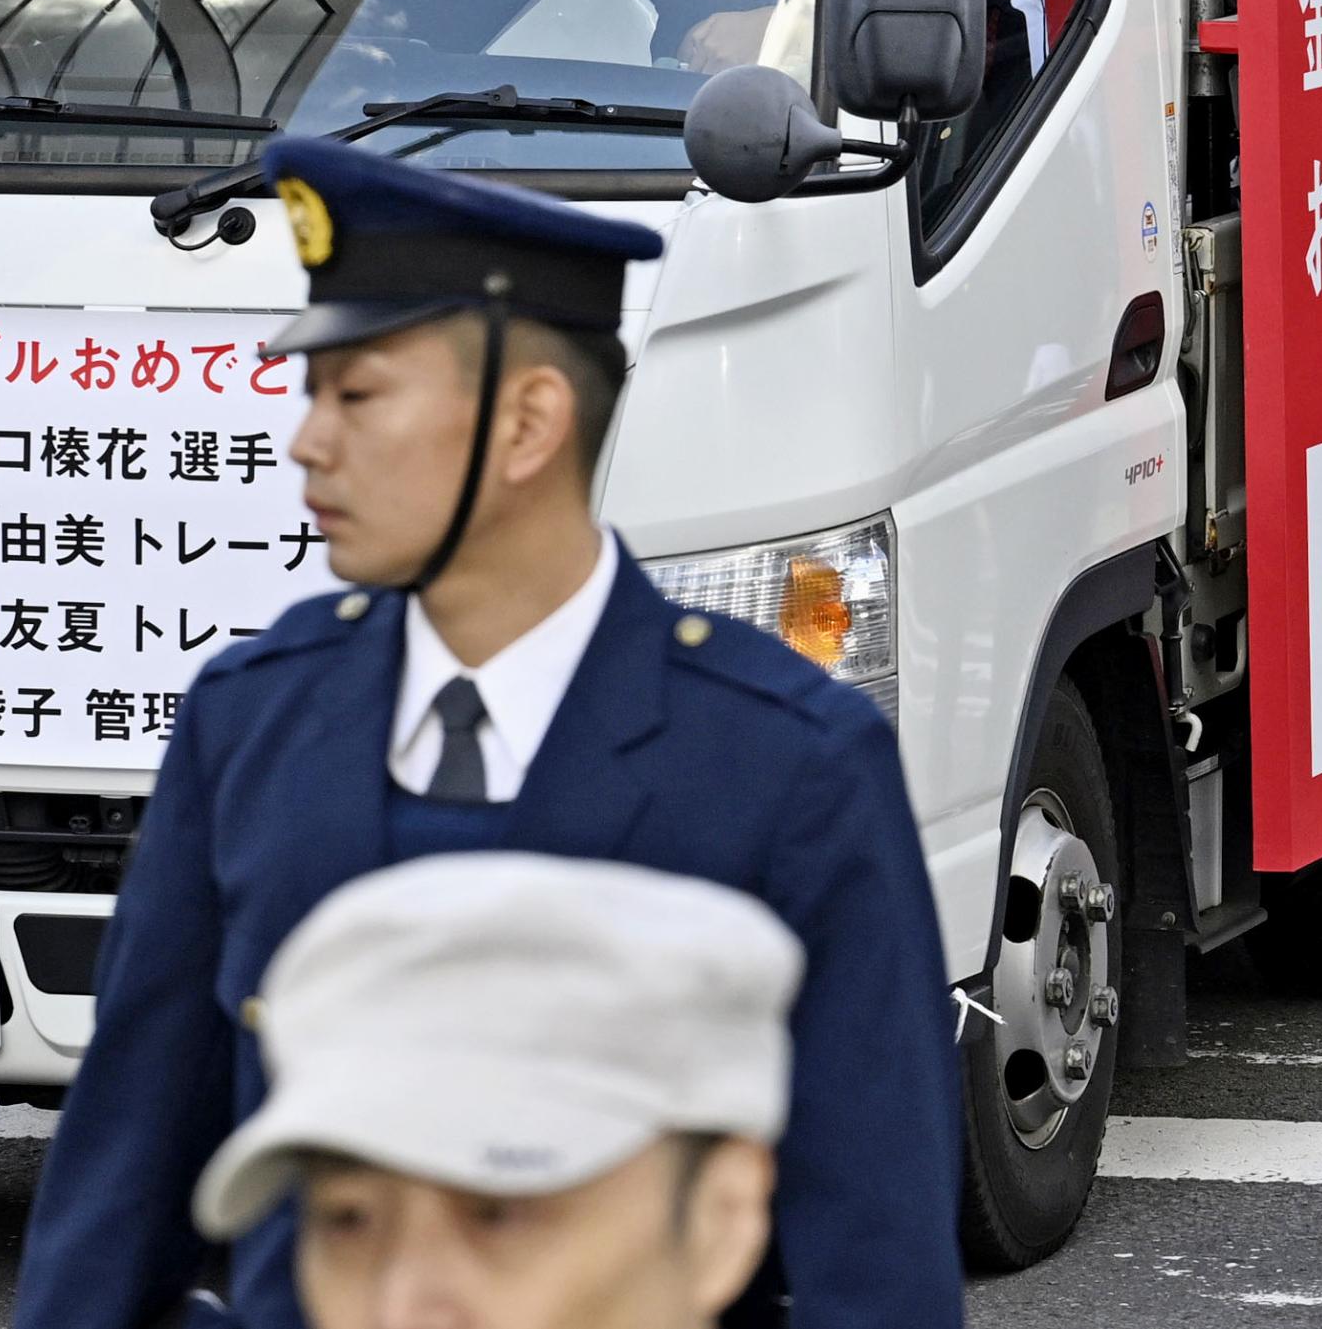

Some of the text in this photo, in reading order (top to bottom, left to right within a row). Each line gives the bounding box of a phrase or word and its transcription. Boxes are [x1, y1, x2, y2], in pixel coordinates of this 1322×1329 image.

[168, 430, 279, 485] 選手
[1124, 453, 1165, 486] 4P10+
[134, 517, 329, 572] トレーナ
[136, 604, 269, 653] トレー
[84, 687, 188, 742] 管理
